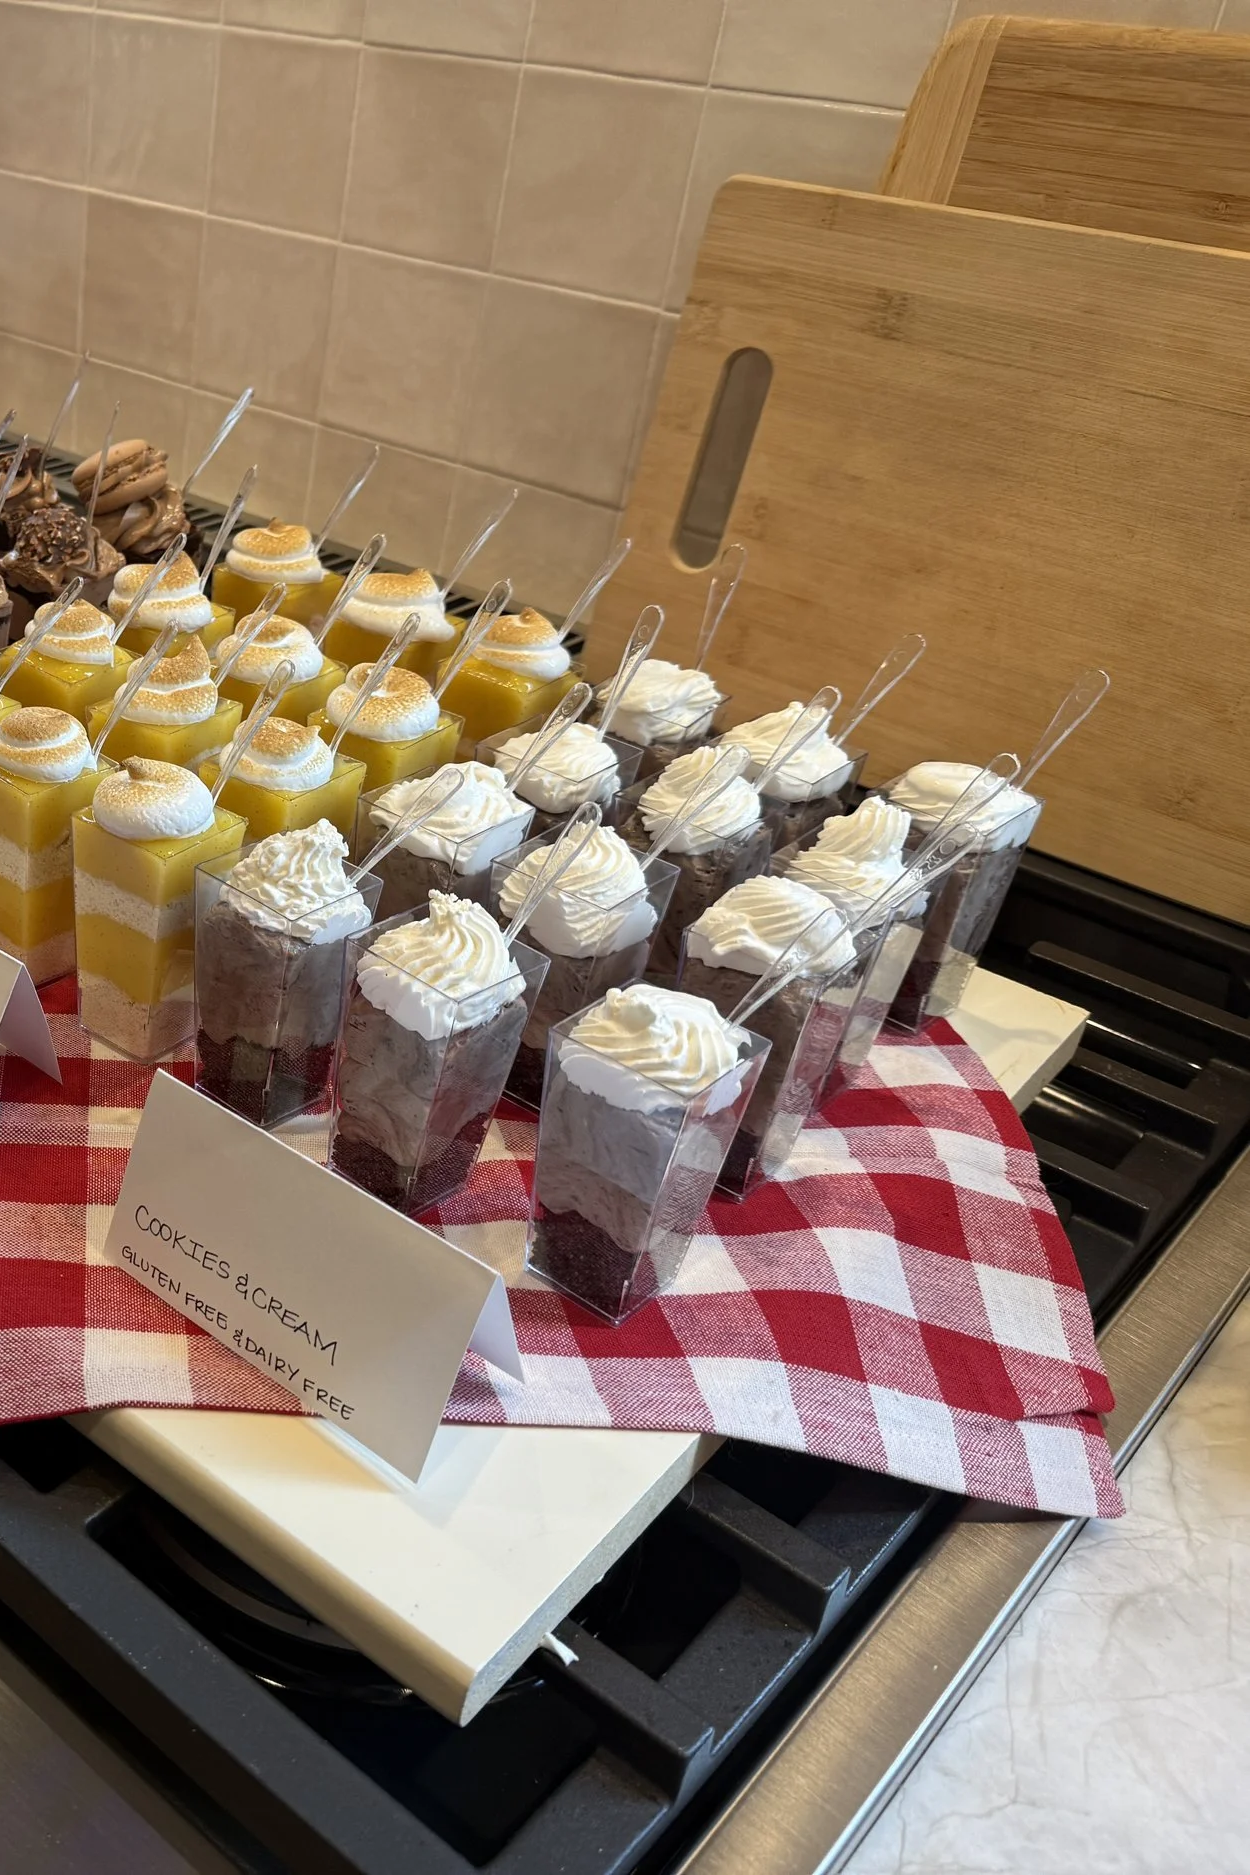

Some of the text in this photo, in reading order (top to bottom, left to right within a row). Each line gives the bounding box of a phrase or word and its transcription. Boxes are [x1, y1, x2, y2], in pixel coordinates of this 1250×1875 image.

[121, 1245, 182, 1295] GLUTEN
[184, 1292, 229, 1331] FREE
[242, 1335, 300, 1384] DAIRY
[302, 1377, 356, 1422] FREE
[135, 1204, 231, 1280] COOKIES
[251, 1287, 338, 1367] CREAM
